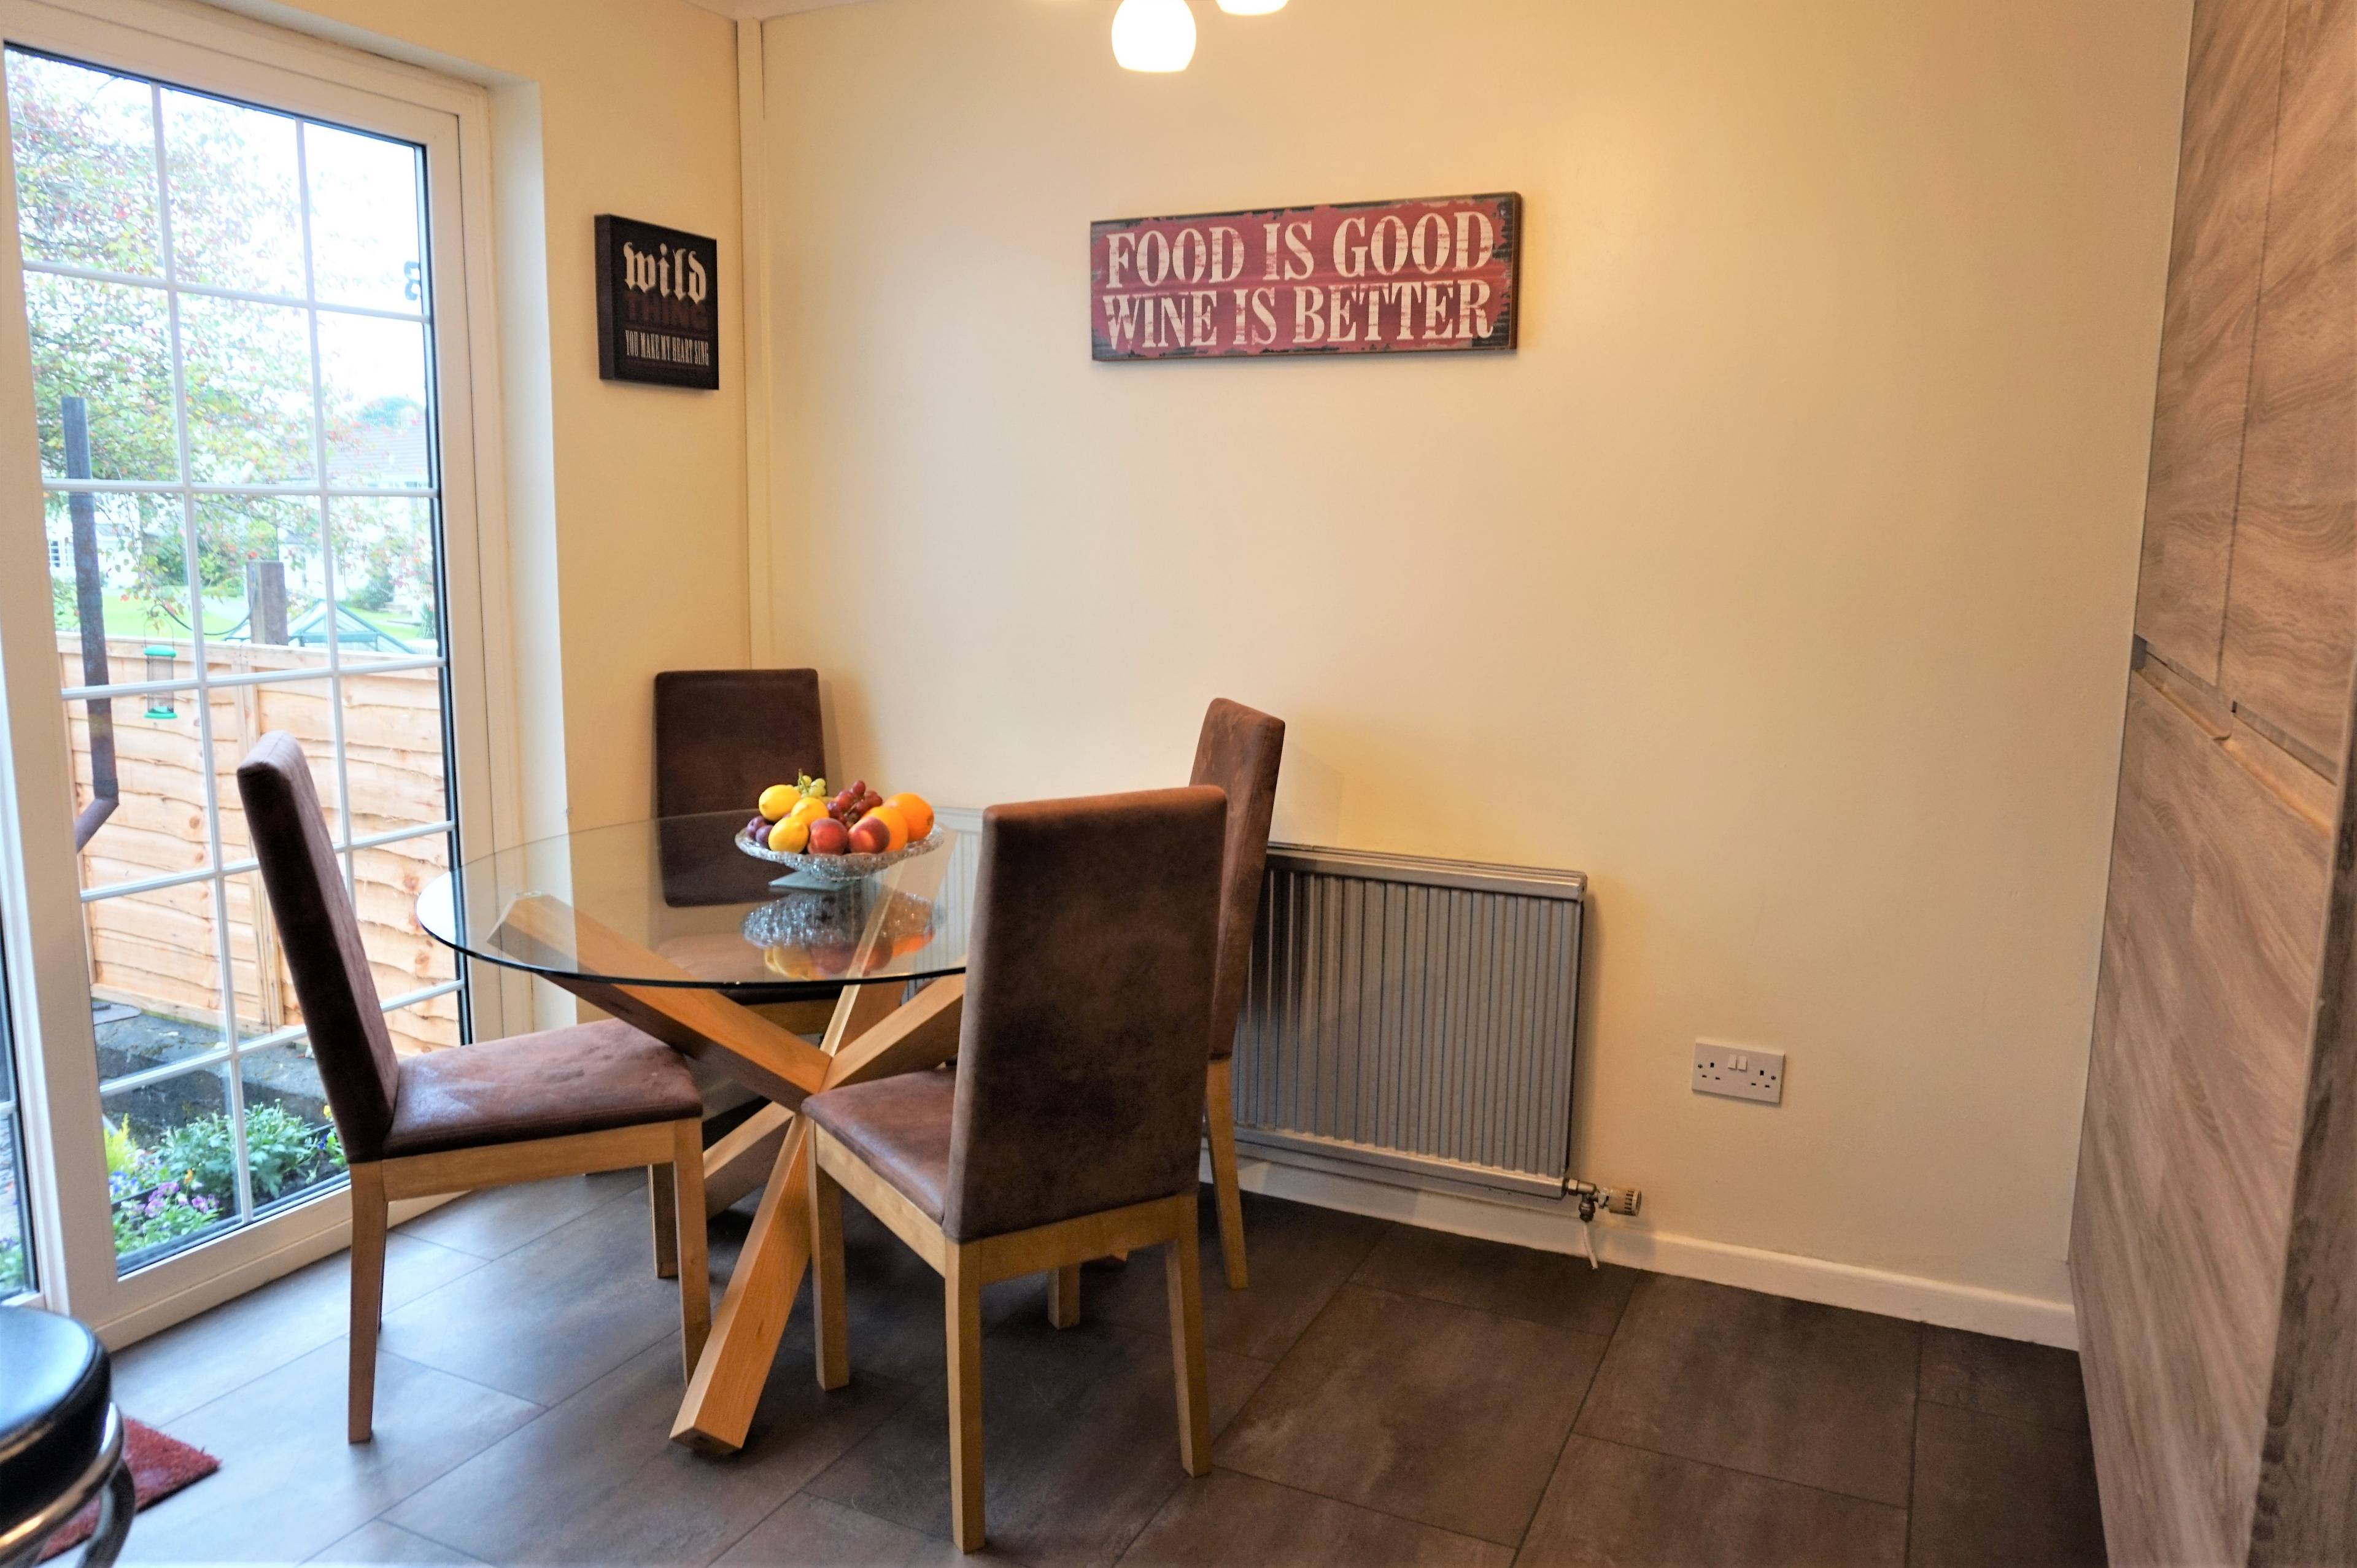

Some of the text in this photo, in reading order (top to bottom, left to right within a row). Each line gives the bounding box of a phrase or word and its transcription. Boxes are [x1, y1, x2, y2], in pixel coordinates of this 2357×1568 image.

[624, 241, 706, 304] wild
[1106, 211, 1495, 288] FOOD IS GOOD
[625, 330, 709, 366] YOU MAKE MY HEART SING
[1102, 279, 1493, 350] WINE IS BETTER
